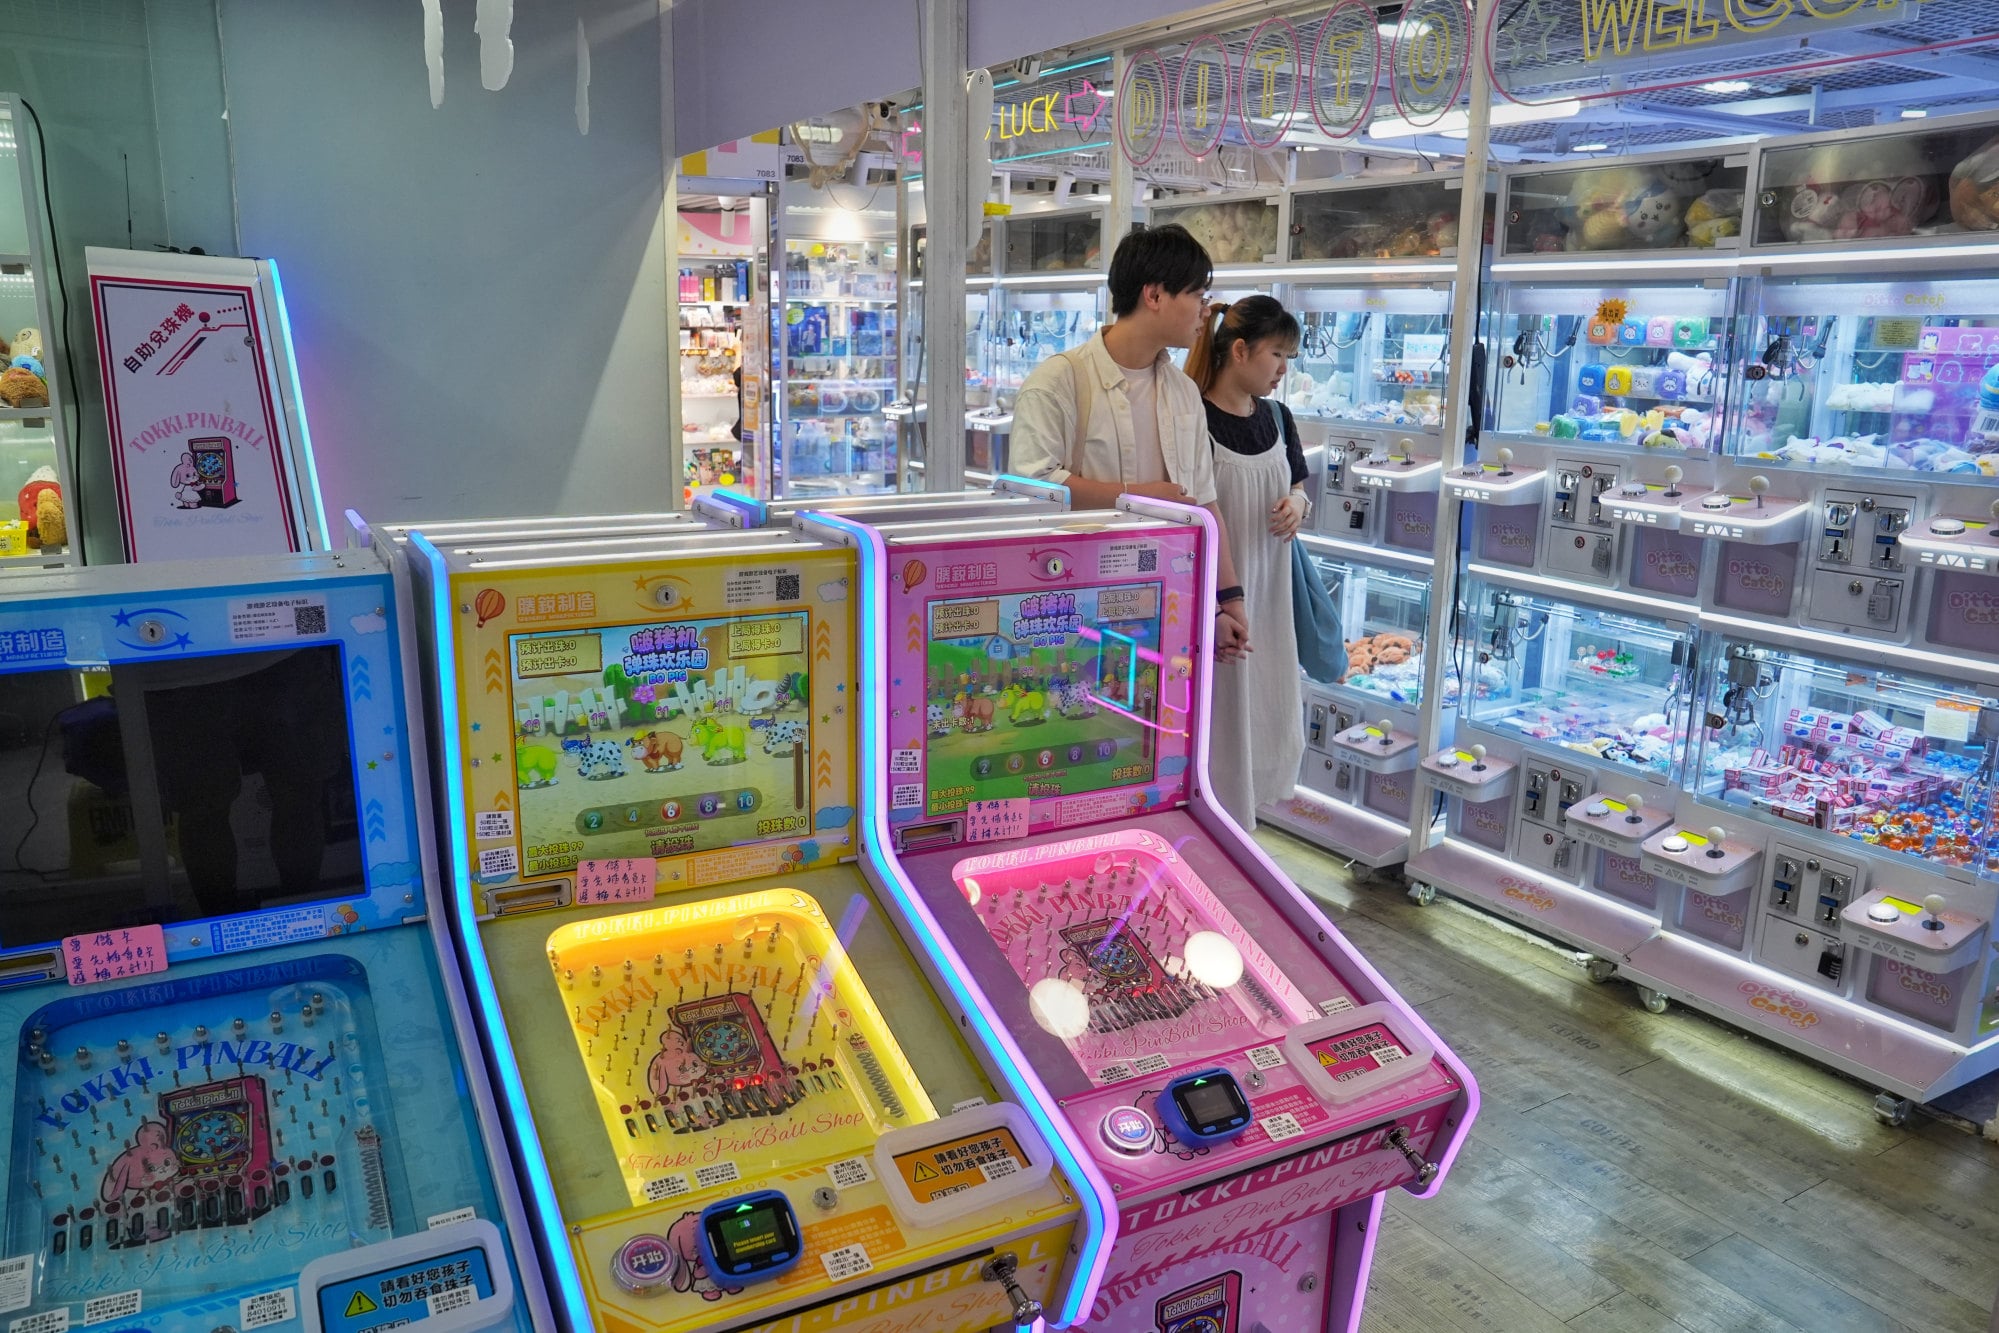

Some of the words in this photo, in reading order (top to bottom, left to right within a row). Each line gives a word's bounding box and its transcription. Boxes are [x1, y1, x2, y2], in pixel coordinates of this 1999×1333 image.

[1582, 0, 1896, 60] WEL
[1130, 11, 1452, 140] DITTO
[1000, 91, 1059, 139] LUCK
[786, 154, 804, 164] 7083
[756, 169, 776, 178] 7083
[1647, 551, 1682, 565] Ditto
[1729, 560, 1770, 576] Ditto
[1658, 562, 1696, 580] Catch
[1740, 574, 1784, 597] Catch
[1964, 607, 1999, 624] Cat
[519, 639, 577, 655] 预计出珠:0
[1049, 634, 1065, 646] PIG
[520, 655, 578, 671] 预计出卡:0
[622, 648, 709, 678] 弹珠欢乐园
[648, 672, 665, 685] BO
[667, 669, 688, 683] PIG
[589, 815, 598, 828] 2
[628, 810, 637, 822] 4
[667, 805, 676, 818] 6
[704, 800, 714, 813] 8
[738, 795, 755, 808] 10
[757, 816, 796, 836] 投珠数
[797, 816, 807, 829] 0
[527, 842, 570, 859] 最大投珠
[571, 841, 585, 852] 99
[528, 858, 570, 873] 最小投珠
[572, 855, 579, 866] 5
[1609, 857, 1642, 872] Ditto
[1498, 876, 1548, 897] Ditto
[1619, 870, 1655, 891] Catch
[1504, 887, 1557, 911] Catch
[1693, 893, 1731, 912] Ditto
[1703, 908, 1743, 930] Catch
[1887, 958, 1936, 982] Ditto
[1738, 980, 1808, 1009] Ditto
[1900, 975, 1951, 1006] Catch
[1750, 996, 1821, 1029] Catch
[1206, 1014, 1250, 1034] Shop
[175, 1038, 338, 1083] PINBALL
[703, 1118, 809, 1162] PinBall
[810, 1111, 866, 1134] Shop
[934, 1137, 1002, 1164] 請看好您孩子
[941, 1149, 1009, 1176] 切勿吞食珠子
[1126, 1115, 1430, 1230] TOKKI·PINBAL
[279, 1219, 347, 1248] Shop
[631, 1249, 665, 1269] 开始
[380, 1260, 471, 1294] 請看好您孩子
[383, 1274, 474, 1309] 切勿吞食珠子
[247, 1303, 287, 1318] 84010911
[1166, 1299, 1190, 1317] Tokki
[1190, 1289, 1221, 1309] PinBall
